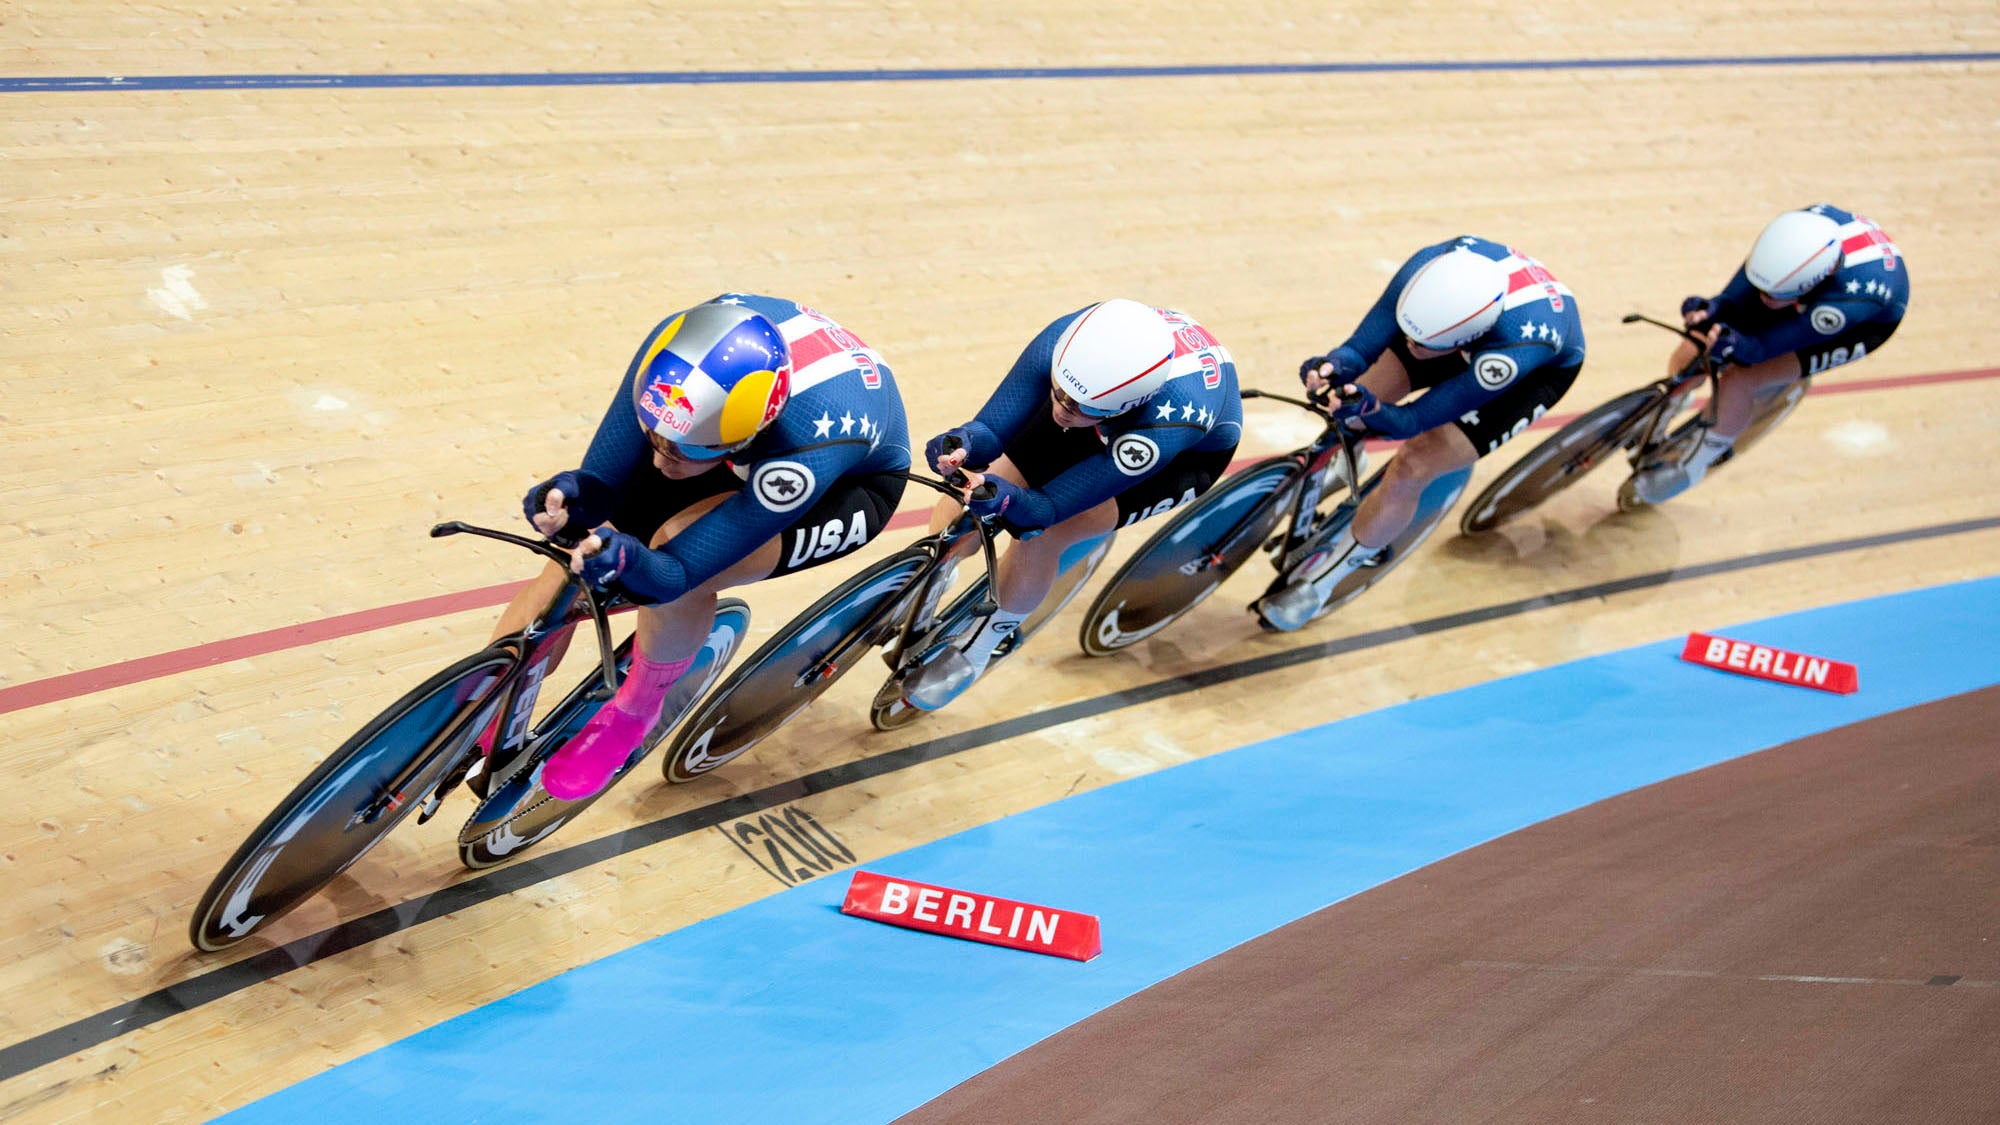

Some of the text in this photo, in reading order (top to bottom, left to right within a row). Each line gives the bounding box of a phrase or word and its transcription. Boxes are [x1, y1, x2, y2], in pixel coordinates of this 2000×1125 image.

[1062, 368, 1088, 395] GIRO
[640, 391, 692, 435] Red Bull
[787, 509, 867, 568] USA
[1705, 638, 1830, 685] BERLIN
[734, 806, 857, 883] 200
[879, 881, 1060, 945] BERLIN
